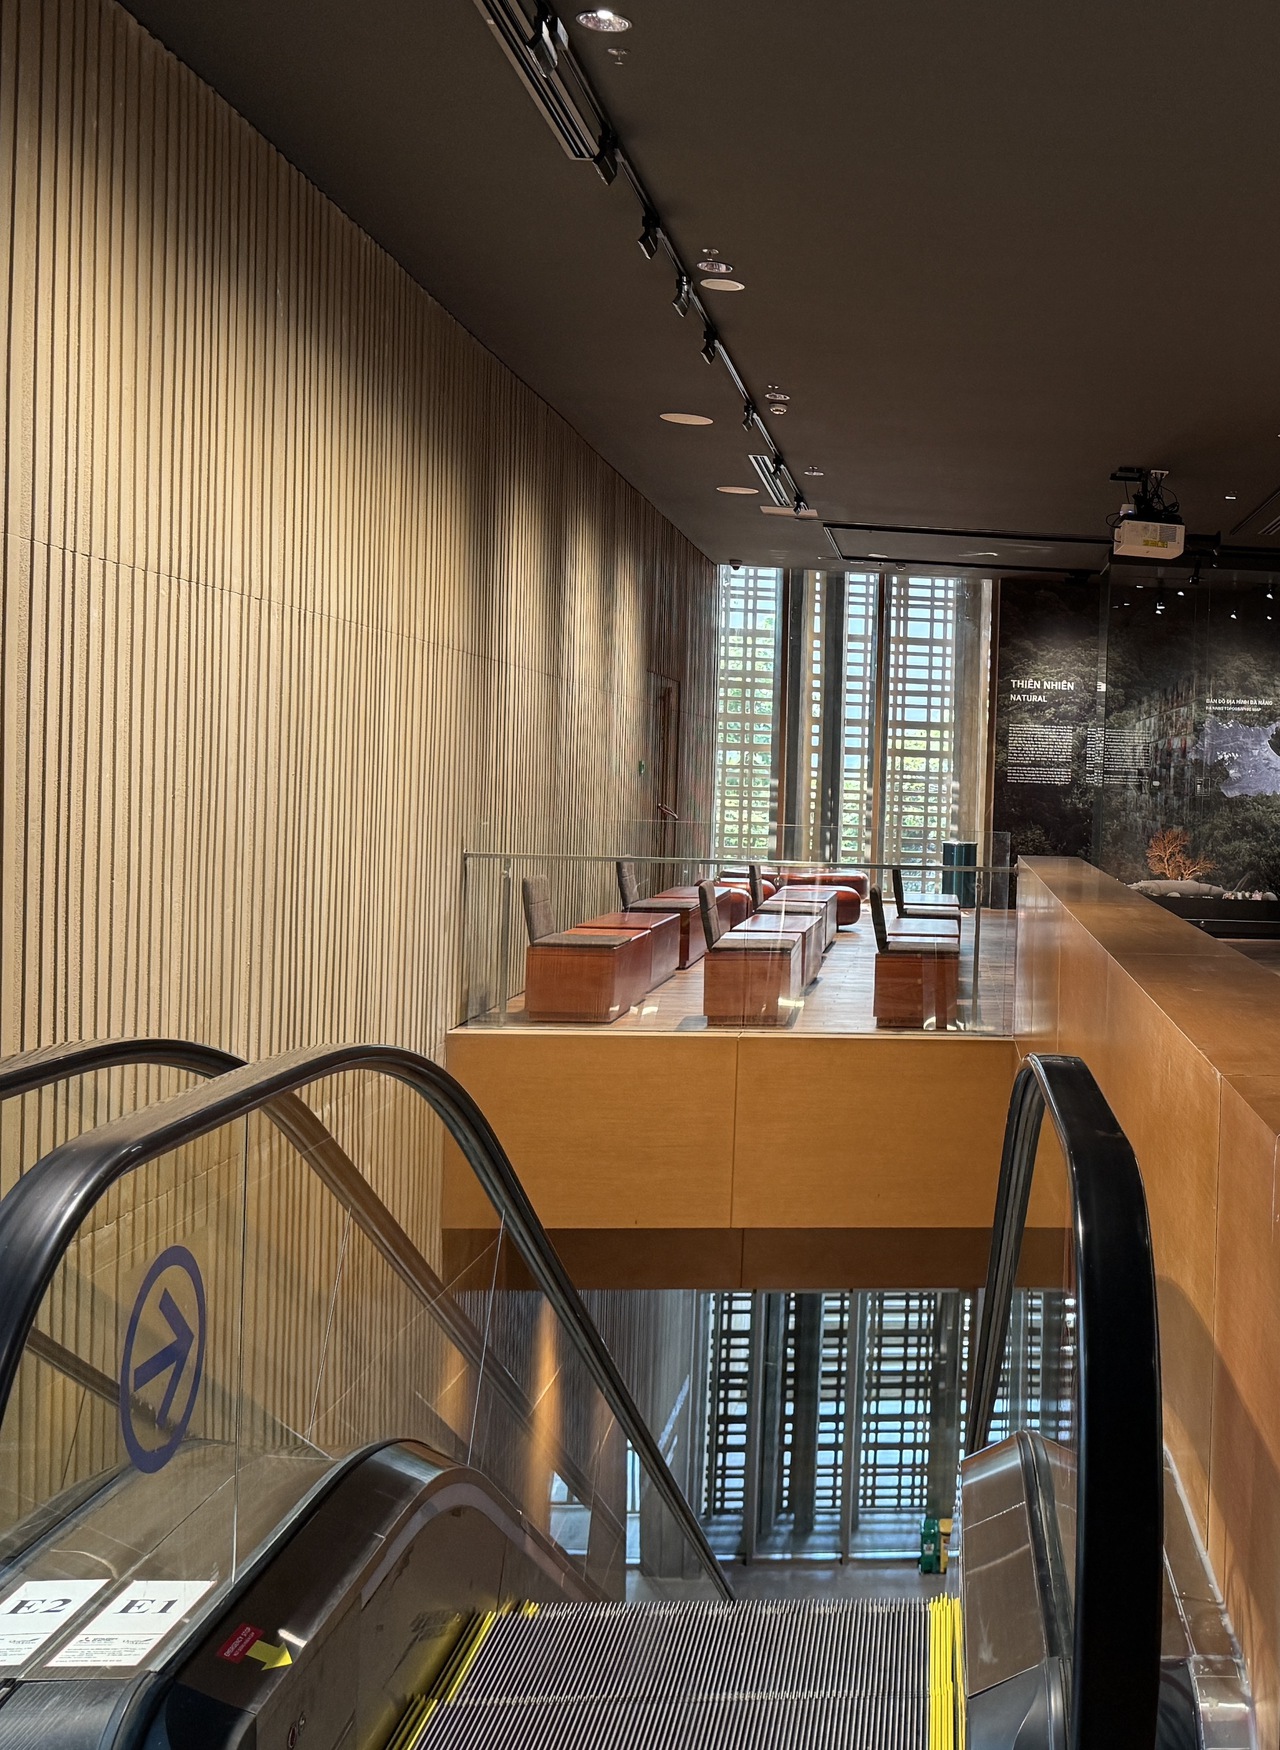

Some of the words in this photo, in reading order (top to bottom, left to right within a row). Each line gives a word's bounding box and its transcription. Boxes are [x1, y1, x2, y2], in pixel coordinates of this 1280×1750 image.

[1010, 678, 1040, 689] THIÊN
[1043, 680, 1075, 691] NHIÊN
[1010, 693, 1047, 702] NATURAL
[1, 1598, 72, 1615] E2
[112, 1598, 178, 1615] E1
